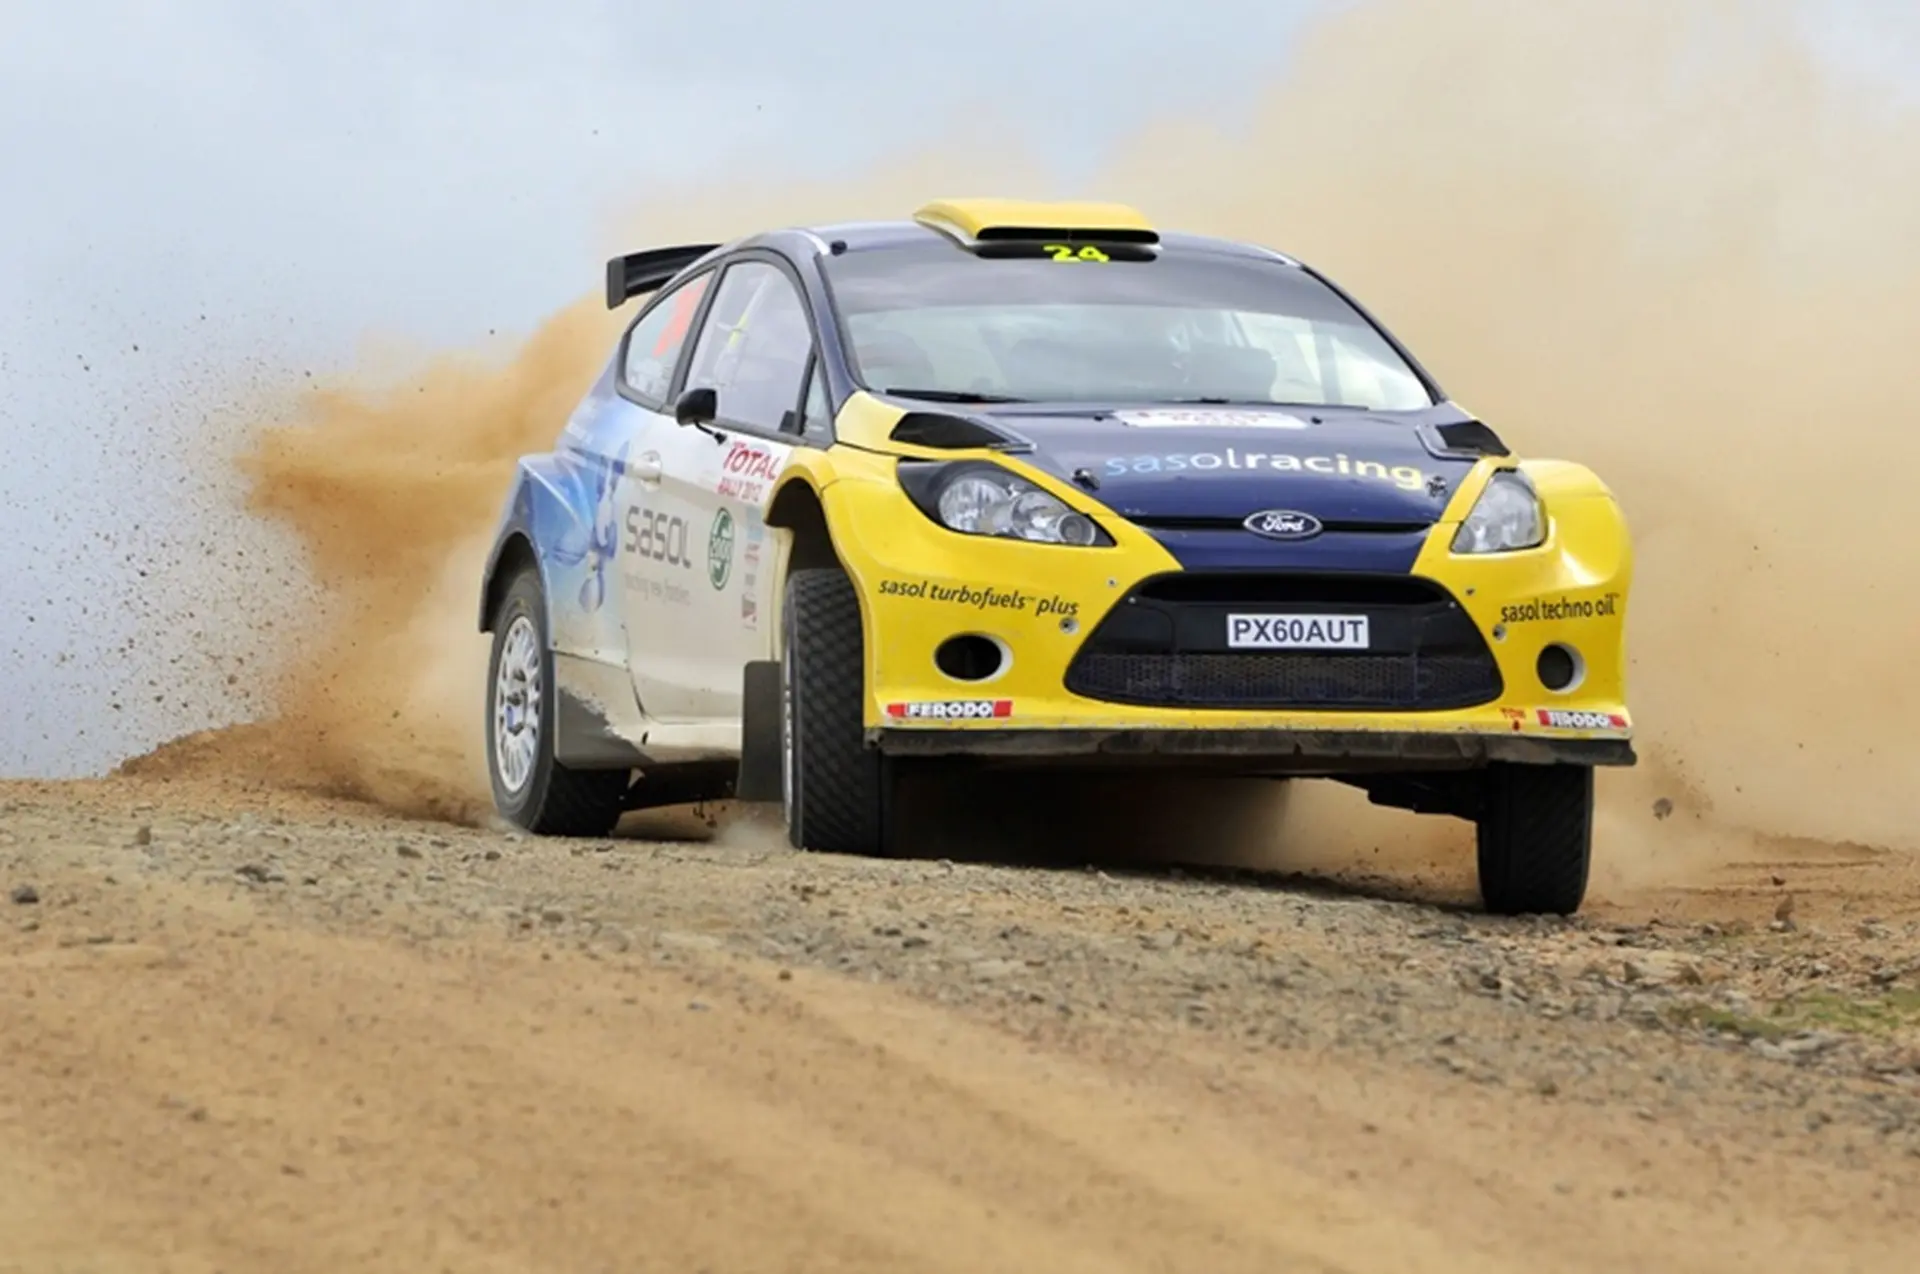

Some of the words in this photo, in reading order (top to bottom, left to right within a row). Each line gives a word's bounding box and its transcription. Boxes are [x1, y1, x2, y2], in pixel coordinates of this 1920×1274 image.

[1043, 245, 1109, 262] 24
[723, 441, 781, 480] TOTAL
[1105, 448, 1422, 490] sasolracing
[1262, 515, 1304, 532] Ford
[879, 579, 927, 597] sasol
[1036, 595, 1079, 617] plus
[1501, 598, 1539, 622] sasol
[1541, 596, 1593, 619] techno
[1233, 619, 1364, 643] PX60AUT
[908, 701, 992, 718] FERODO
